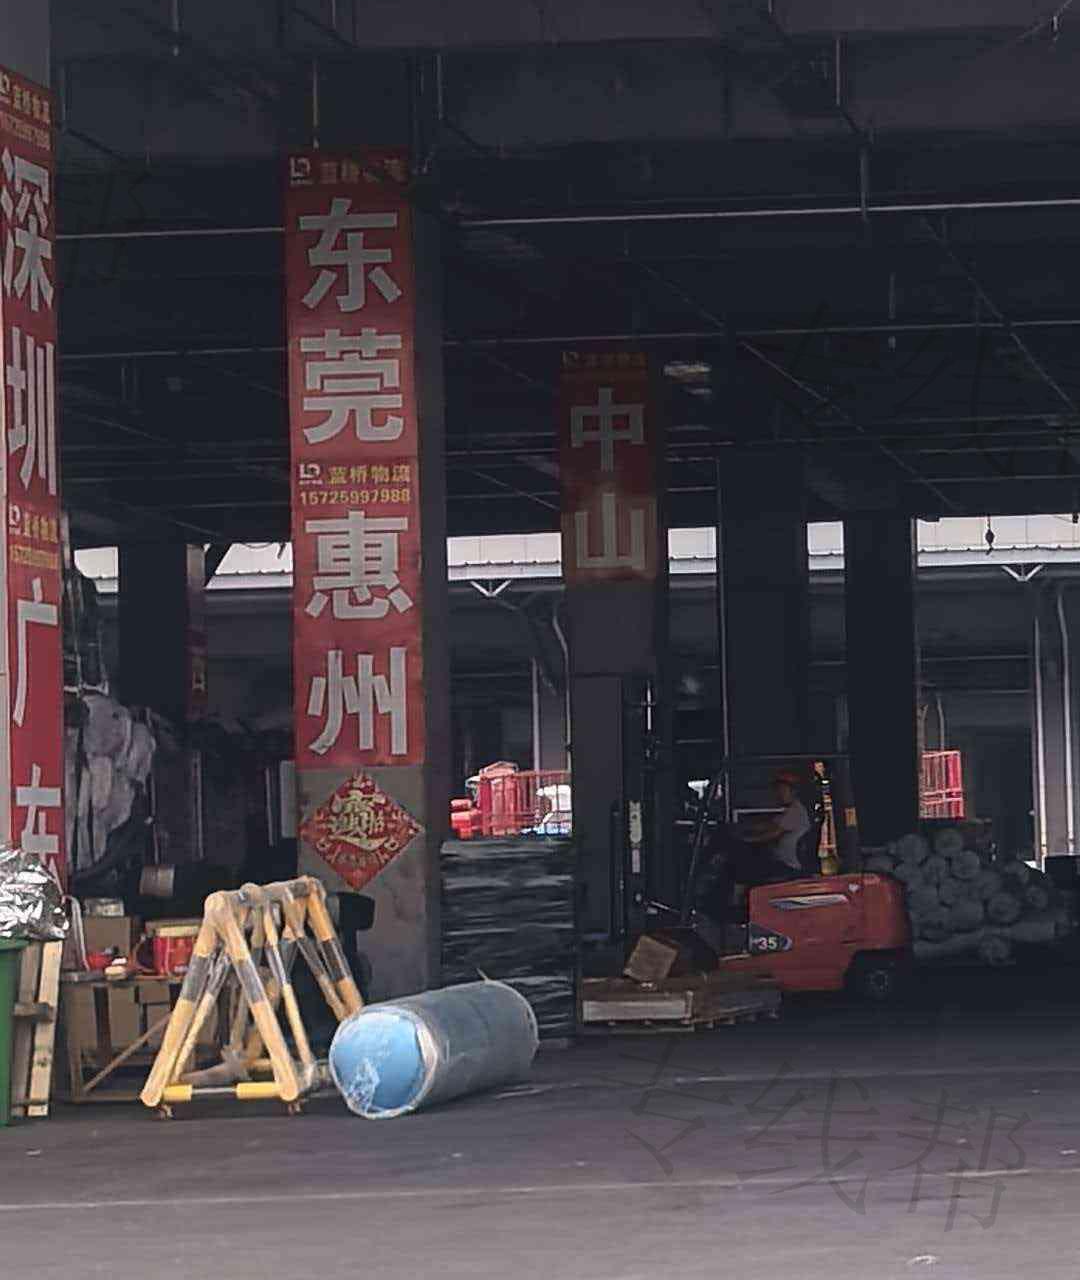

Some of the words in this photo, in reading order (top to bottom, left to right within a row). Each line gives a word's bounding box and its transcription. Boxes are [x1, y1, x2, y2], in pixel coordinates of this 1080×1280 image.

[0, 147, 56, 496] 深圳
[299, 198, 404, 444] 东莞
[570, 387, 648, 570] 中山
[305, 510, 414, 756] 惠州
